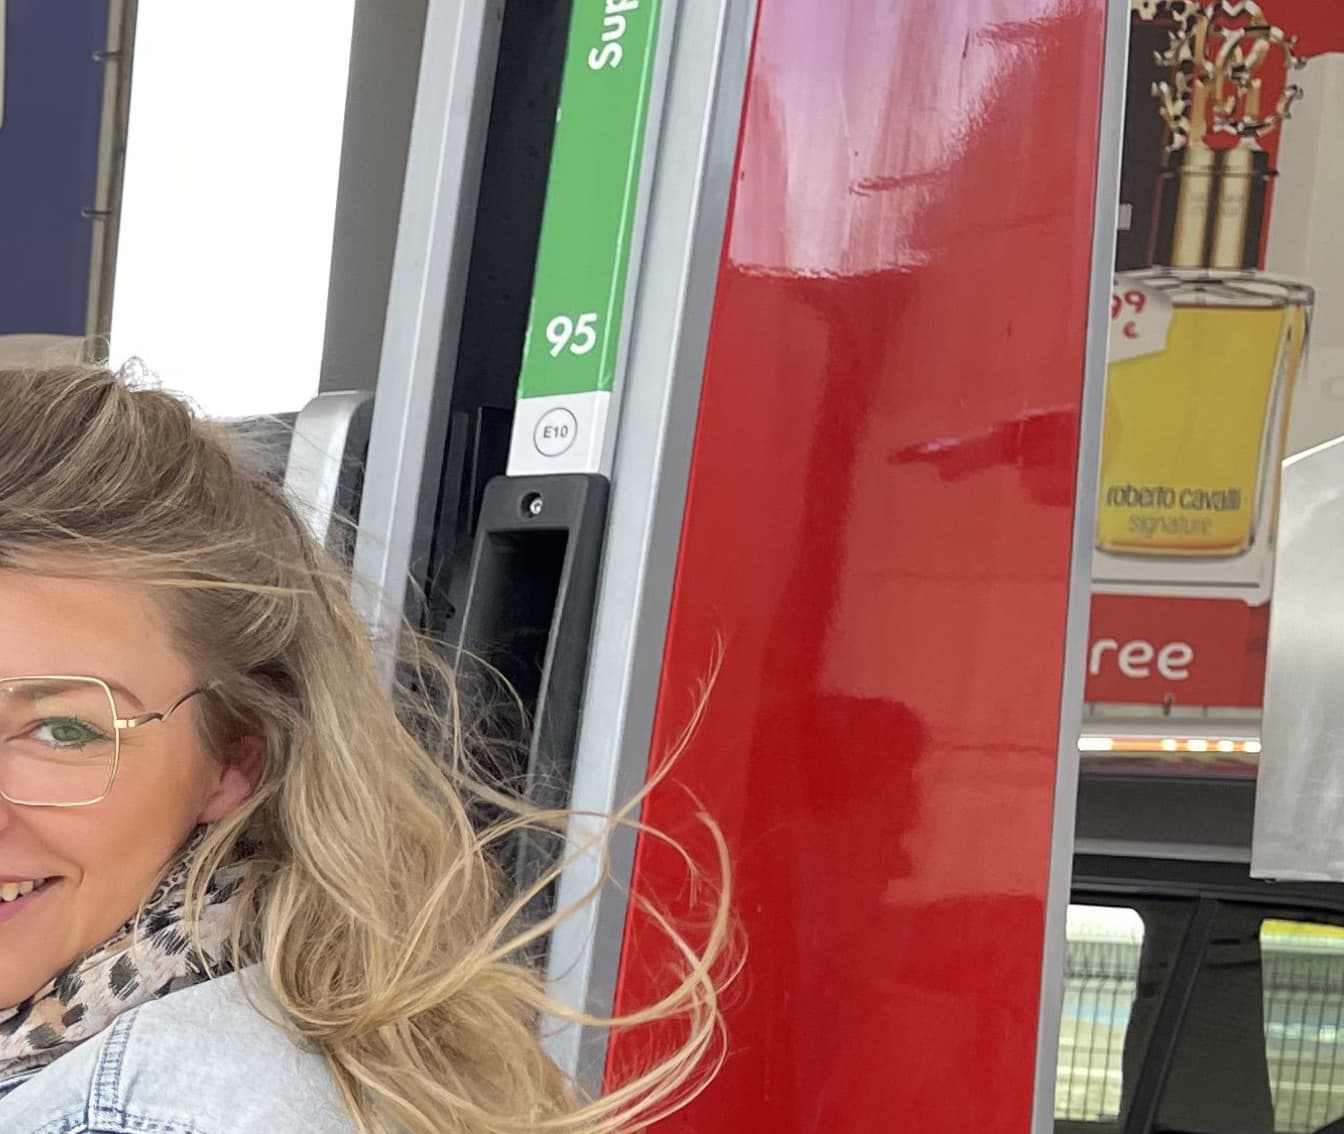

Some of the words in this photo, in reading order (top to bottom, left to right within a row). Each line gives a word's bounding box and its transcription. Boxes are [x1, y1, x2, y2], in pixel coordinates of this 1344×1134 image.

[545, 313, 598, 358] 95
[543, 425, 569, 439] E10
[1107, 482, 1176, 510] roberto
[1089, 637, 1194, 680] ree
